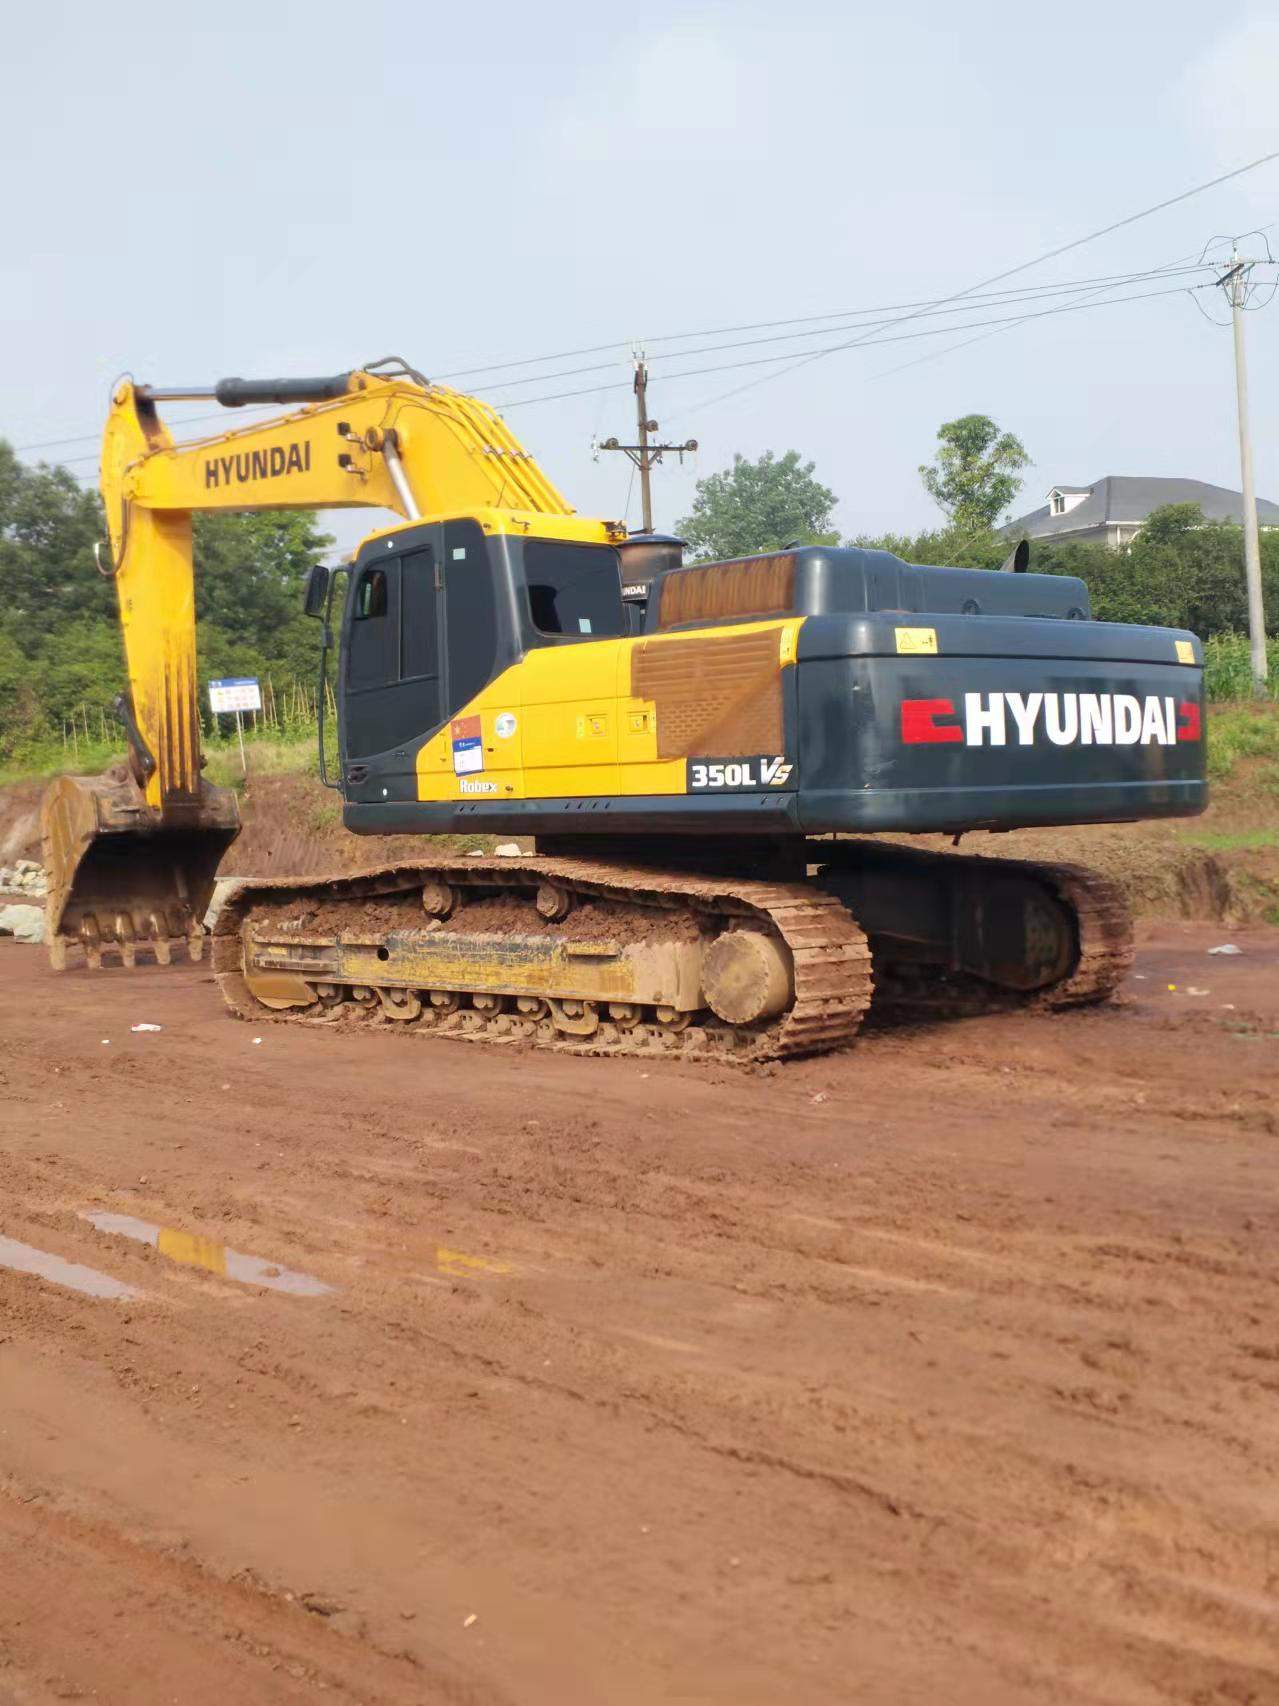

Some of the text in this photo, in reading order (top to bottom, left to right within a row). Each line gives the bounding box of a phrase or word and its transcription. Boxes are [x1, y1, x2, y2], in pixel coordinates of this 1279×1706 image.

[205, 440, 311, 489] HYUNDAI
[964, 692, 1177, 747] HYUNDAI
[460, 779, 497, 793] Robex
[691, 764, 757, 787] 350L
